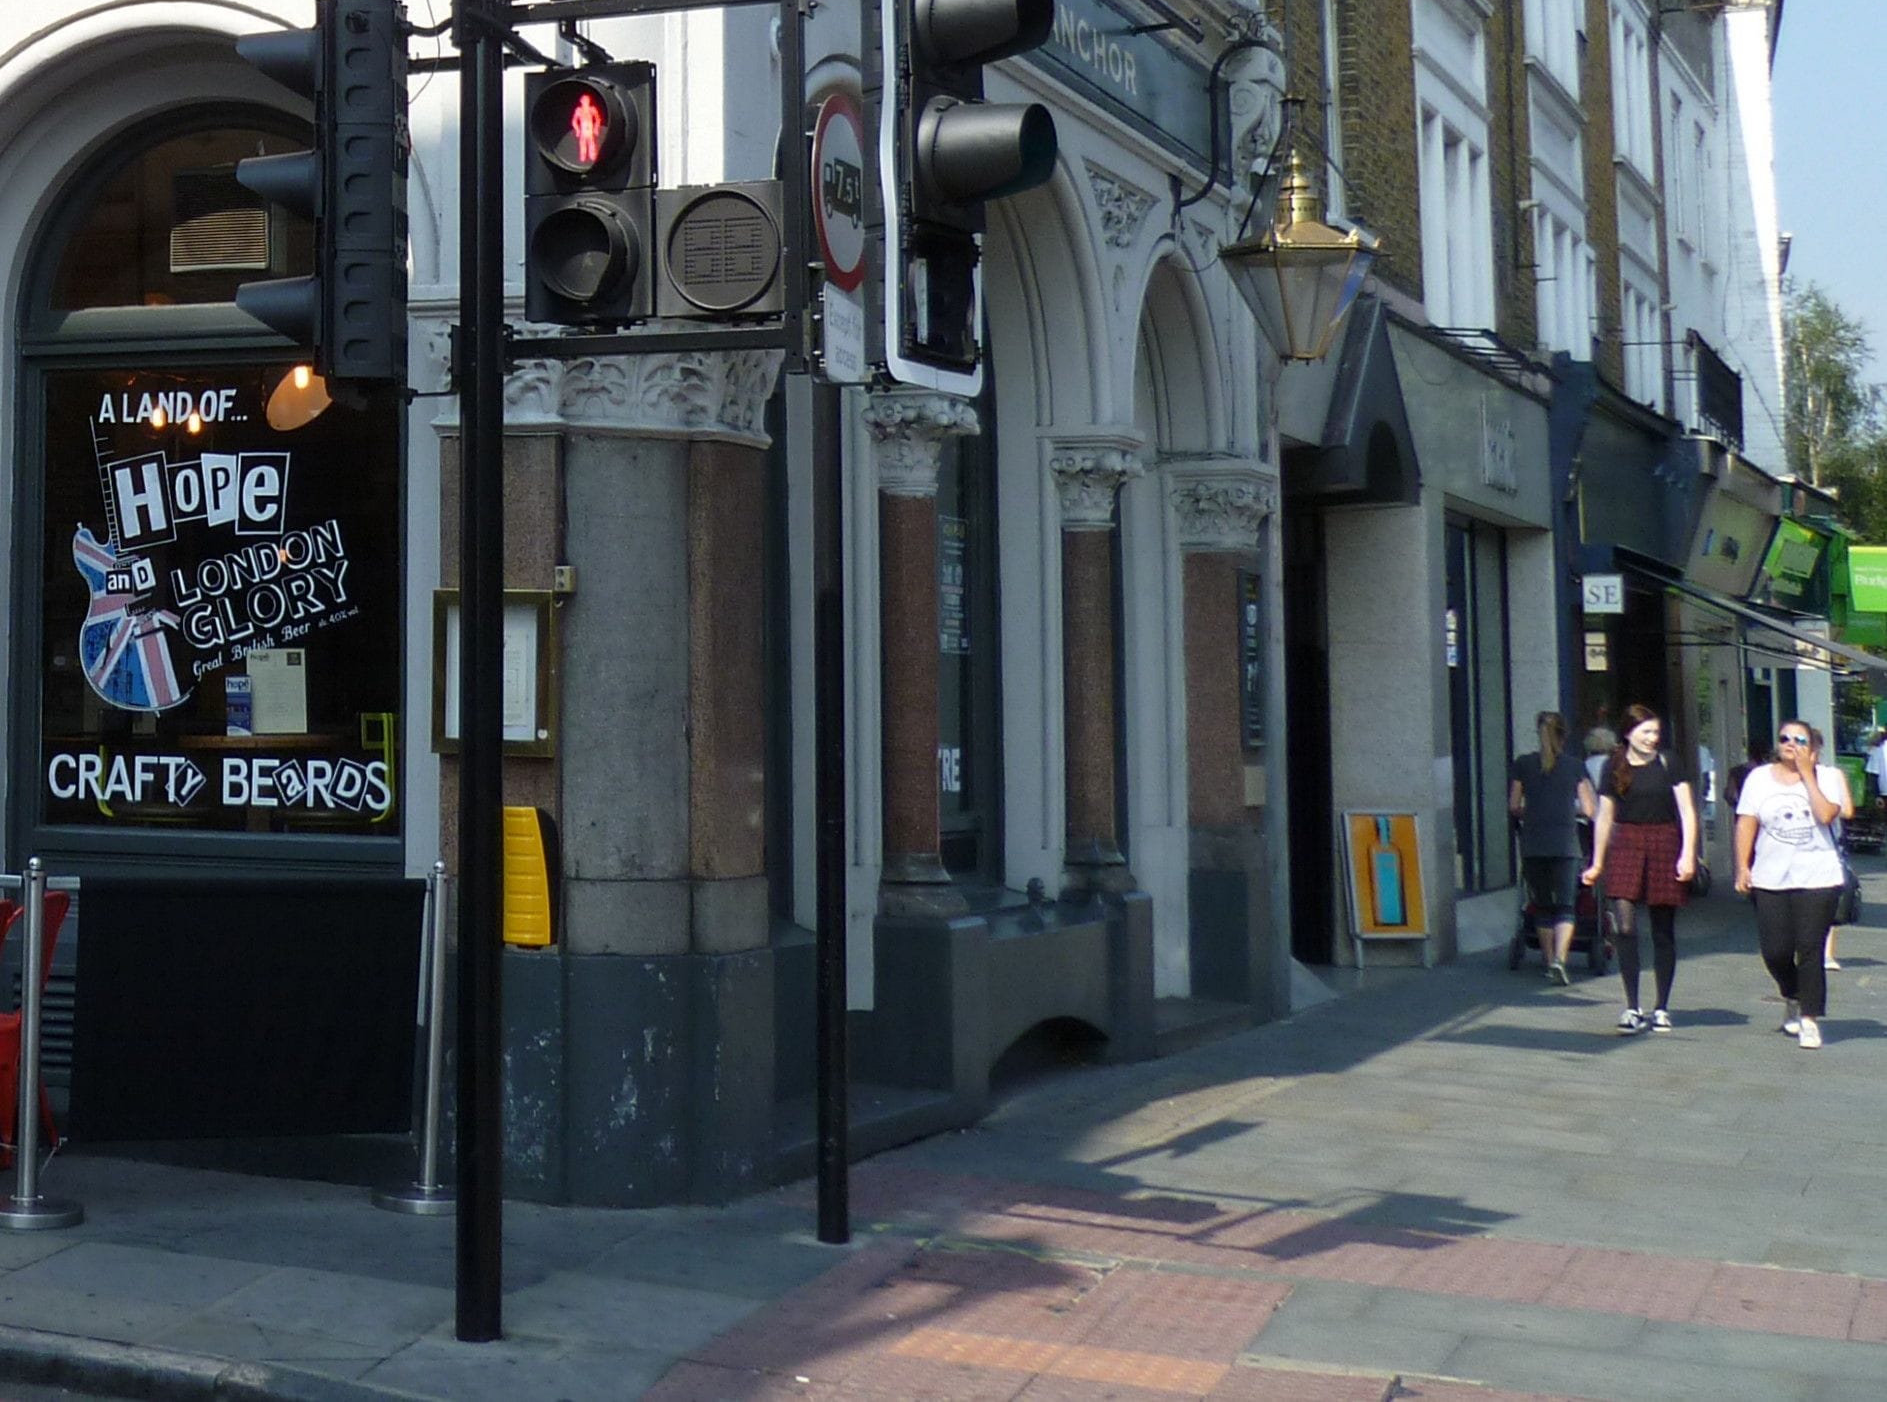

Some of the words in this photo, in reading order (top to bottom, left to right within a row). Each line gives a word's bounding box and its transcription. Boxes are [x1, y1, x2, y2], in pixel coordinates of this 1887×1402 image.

[98, 393, 115, 423] A
[122, 391, 193, 425] LAND
[171, 519, 345, 607] LONDON
[182, 559, 349, 648] GLORY
[1586, 585, 1619, 605] SE
[193, 651, 223, 681] Great
[281, 622, 311, 642] Beer
[48, 753, 206, 807] CRAFTY
